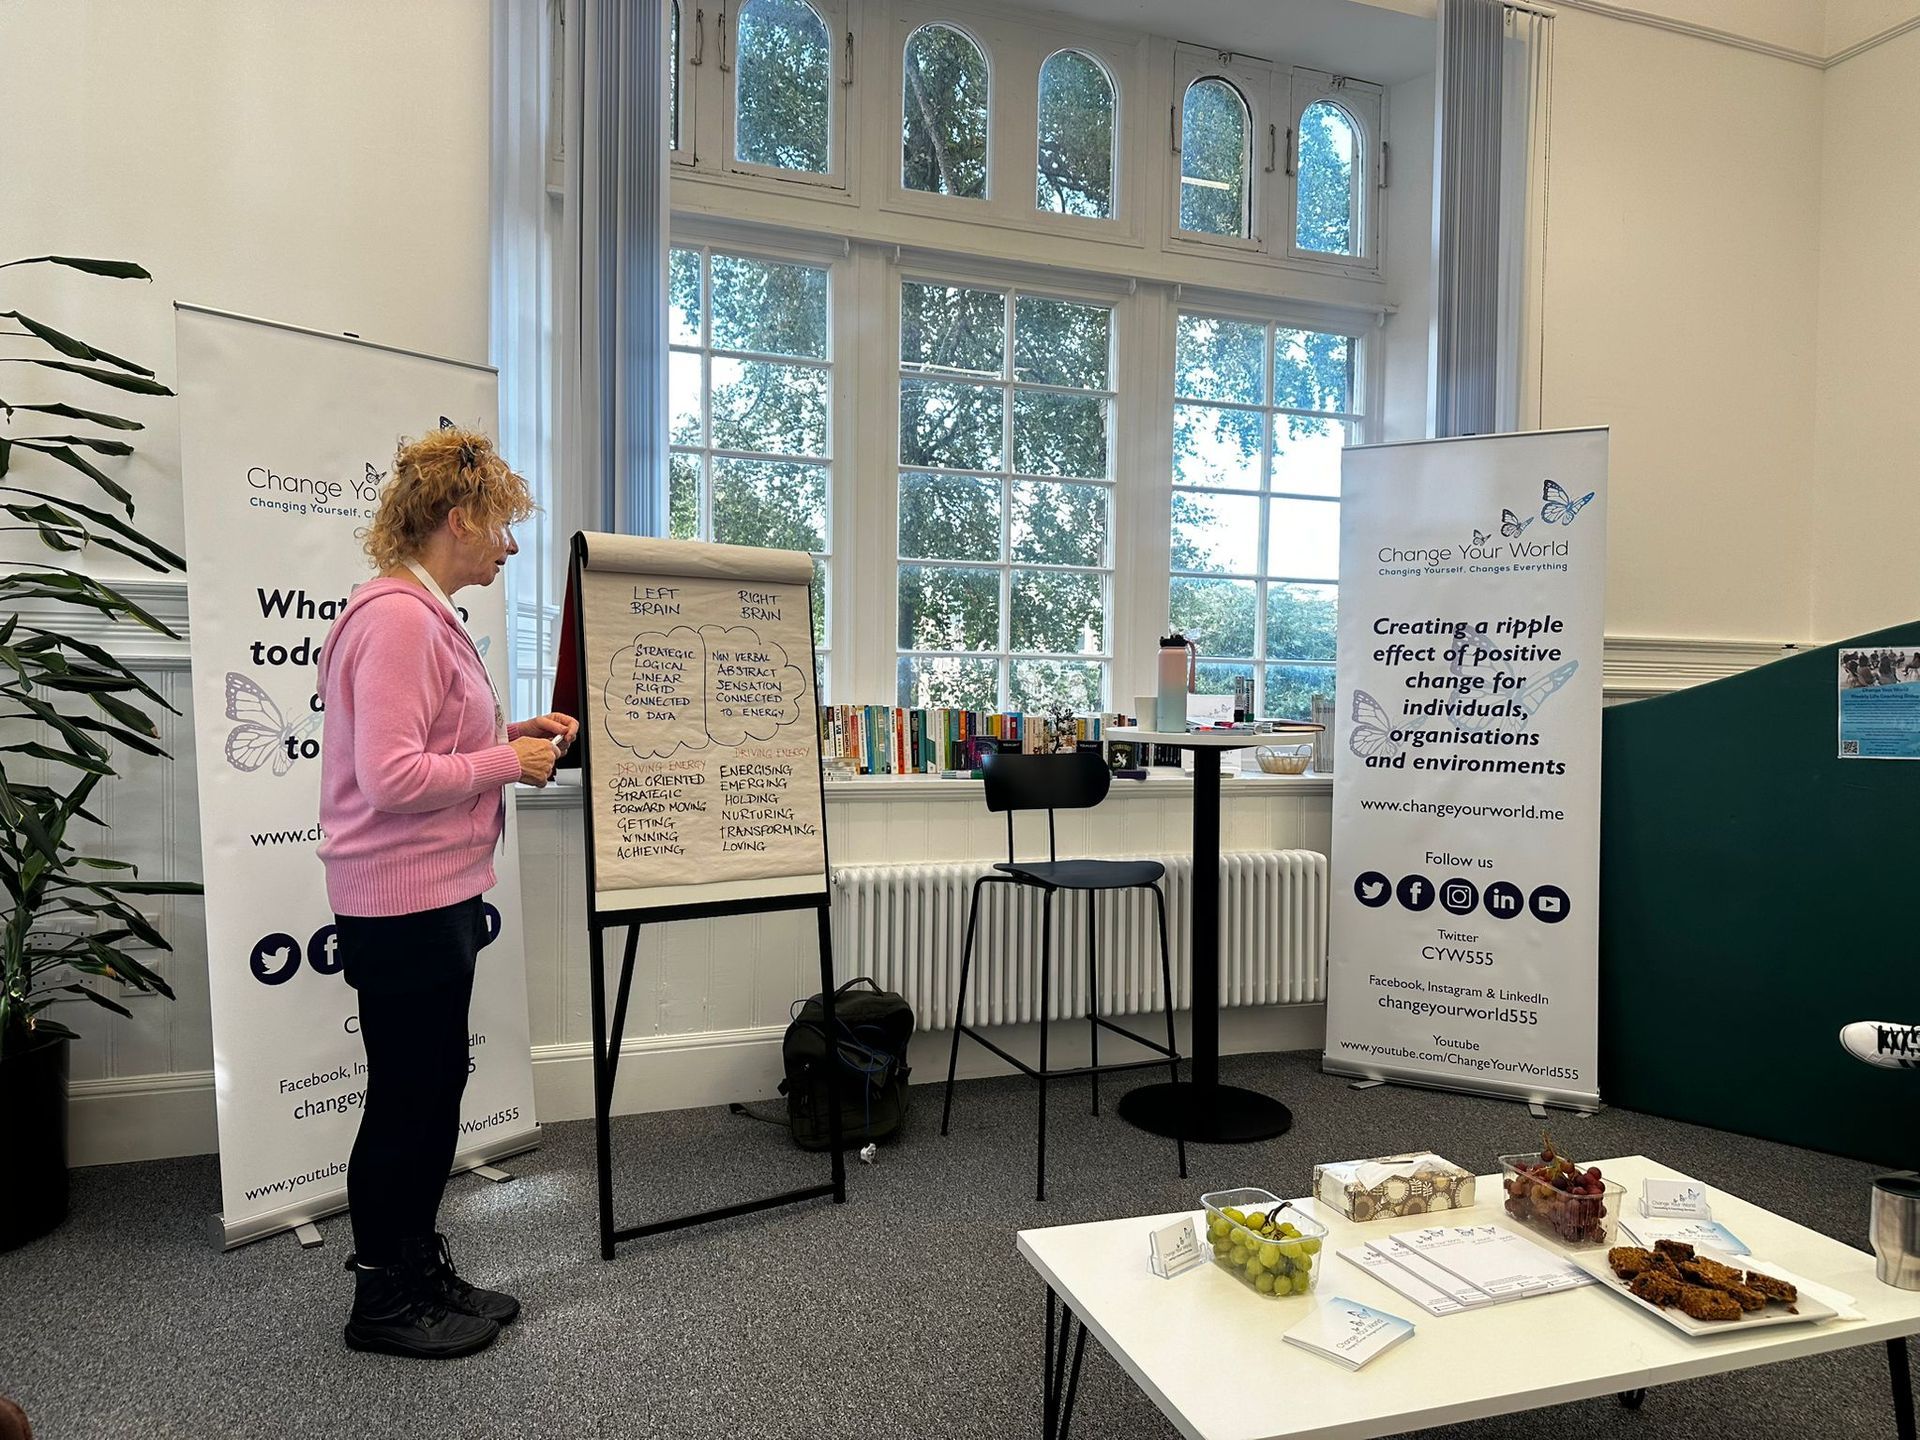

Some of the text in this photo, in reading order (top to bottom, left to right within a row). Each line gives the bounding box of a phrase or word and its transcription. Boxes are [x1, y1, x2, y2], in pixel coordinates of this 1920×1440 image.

[247, 467, 342, 504] Change
[250, 497, 306, 514] Changing
[1378, 540, 1569, 566] Change Your World
[1378, 568, 1421, 577] Changing
[1469, 565, 1511, 575] Changes
[1513, 563, 1568, 573] Everything
[633, 585, 681, 600] LEFT
[738, 590, 782, 606] RIGHT
[630, 601, 681, 616] BRAIN
[740, 606, 782, 621] BRAIN
[1373, 615, 1564, 639] Creating a ripple
[635, 644, 697, 659] STRATEGIC
[712, 650, 771, 662] NON VERBAL
[1373, 644, 1562, 666] effect of positive
[635, 658, 687, 672] LOGICAL
[717, 666, 778, 678] ABSTRACT
[632, 672, 684, 684] LINEAR
[1405, 672, 1527, 694] change for
[636, 683, 675, 695] RIGID
[716, 680, 782, 692] SENSATION
[625, 695, 691, 706] CONNECTED
[716, 692, 782, 703] CONNECTED
[626, 710, 676, 721] TO DATA
[720, 708, 785, 718] TO ENERGY
[1403, 699, 1529, 721] individuals,
[1389, 726, 1540, 747] organisations
[285, 736, 320, 760] to
[735, 747, 810, 759] DRIVING ENERGY
[615, 760, 706, 776] DRIVING ENERGY
[720, 763, 793, 777] ENERGISING
[1365, 752, 1566, 775] and environments
[608, 773, 706, 793] GOAL ORIENTED
[720, 778, 788, 791] EMERGING
[614, 789, 682, 802] STRATEGIC
[725, 793, 780, 806] HOLDING
[613, 801, 707, 815] FORWARD MOVING
[721, 808, 795, 821] NURTURING
[1360, 800, 1565, 821] www.changeyourworld.me
[617, 817, 677, 830] GETTING
[622, 831, 680, 843] WINNING
[720, 824, 818, 839] TRANSFORMING
[617, 845, 686, 860] ACHIEVING
[723, 841, 768, 852] LOVING
[1425, 852, 1494, 869] Follow us
[1437, 929, 1479, 943] Twitter
[1421, 946, 1494, 966] CYW555
[1369, 975, 1549, 1005] Facebook, Instagram & LinkedIn
[1378, 995, 1538, 1026] changeyourworld555
[1433, 1035, 1480, 1051] Youtube
[1340, 1040, 1580, 1080] www.youtube.com/ChangeYourWorld555
[280, 1066, 351, 1094] Facebook,
